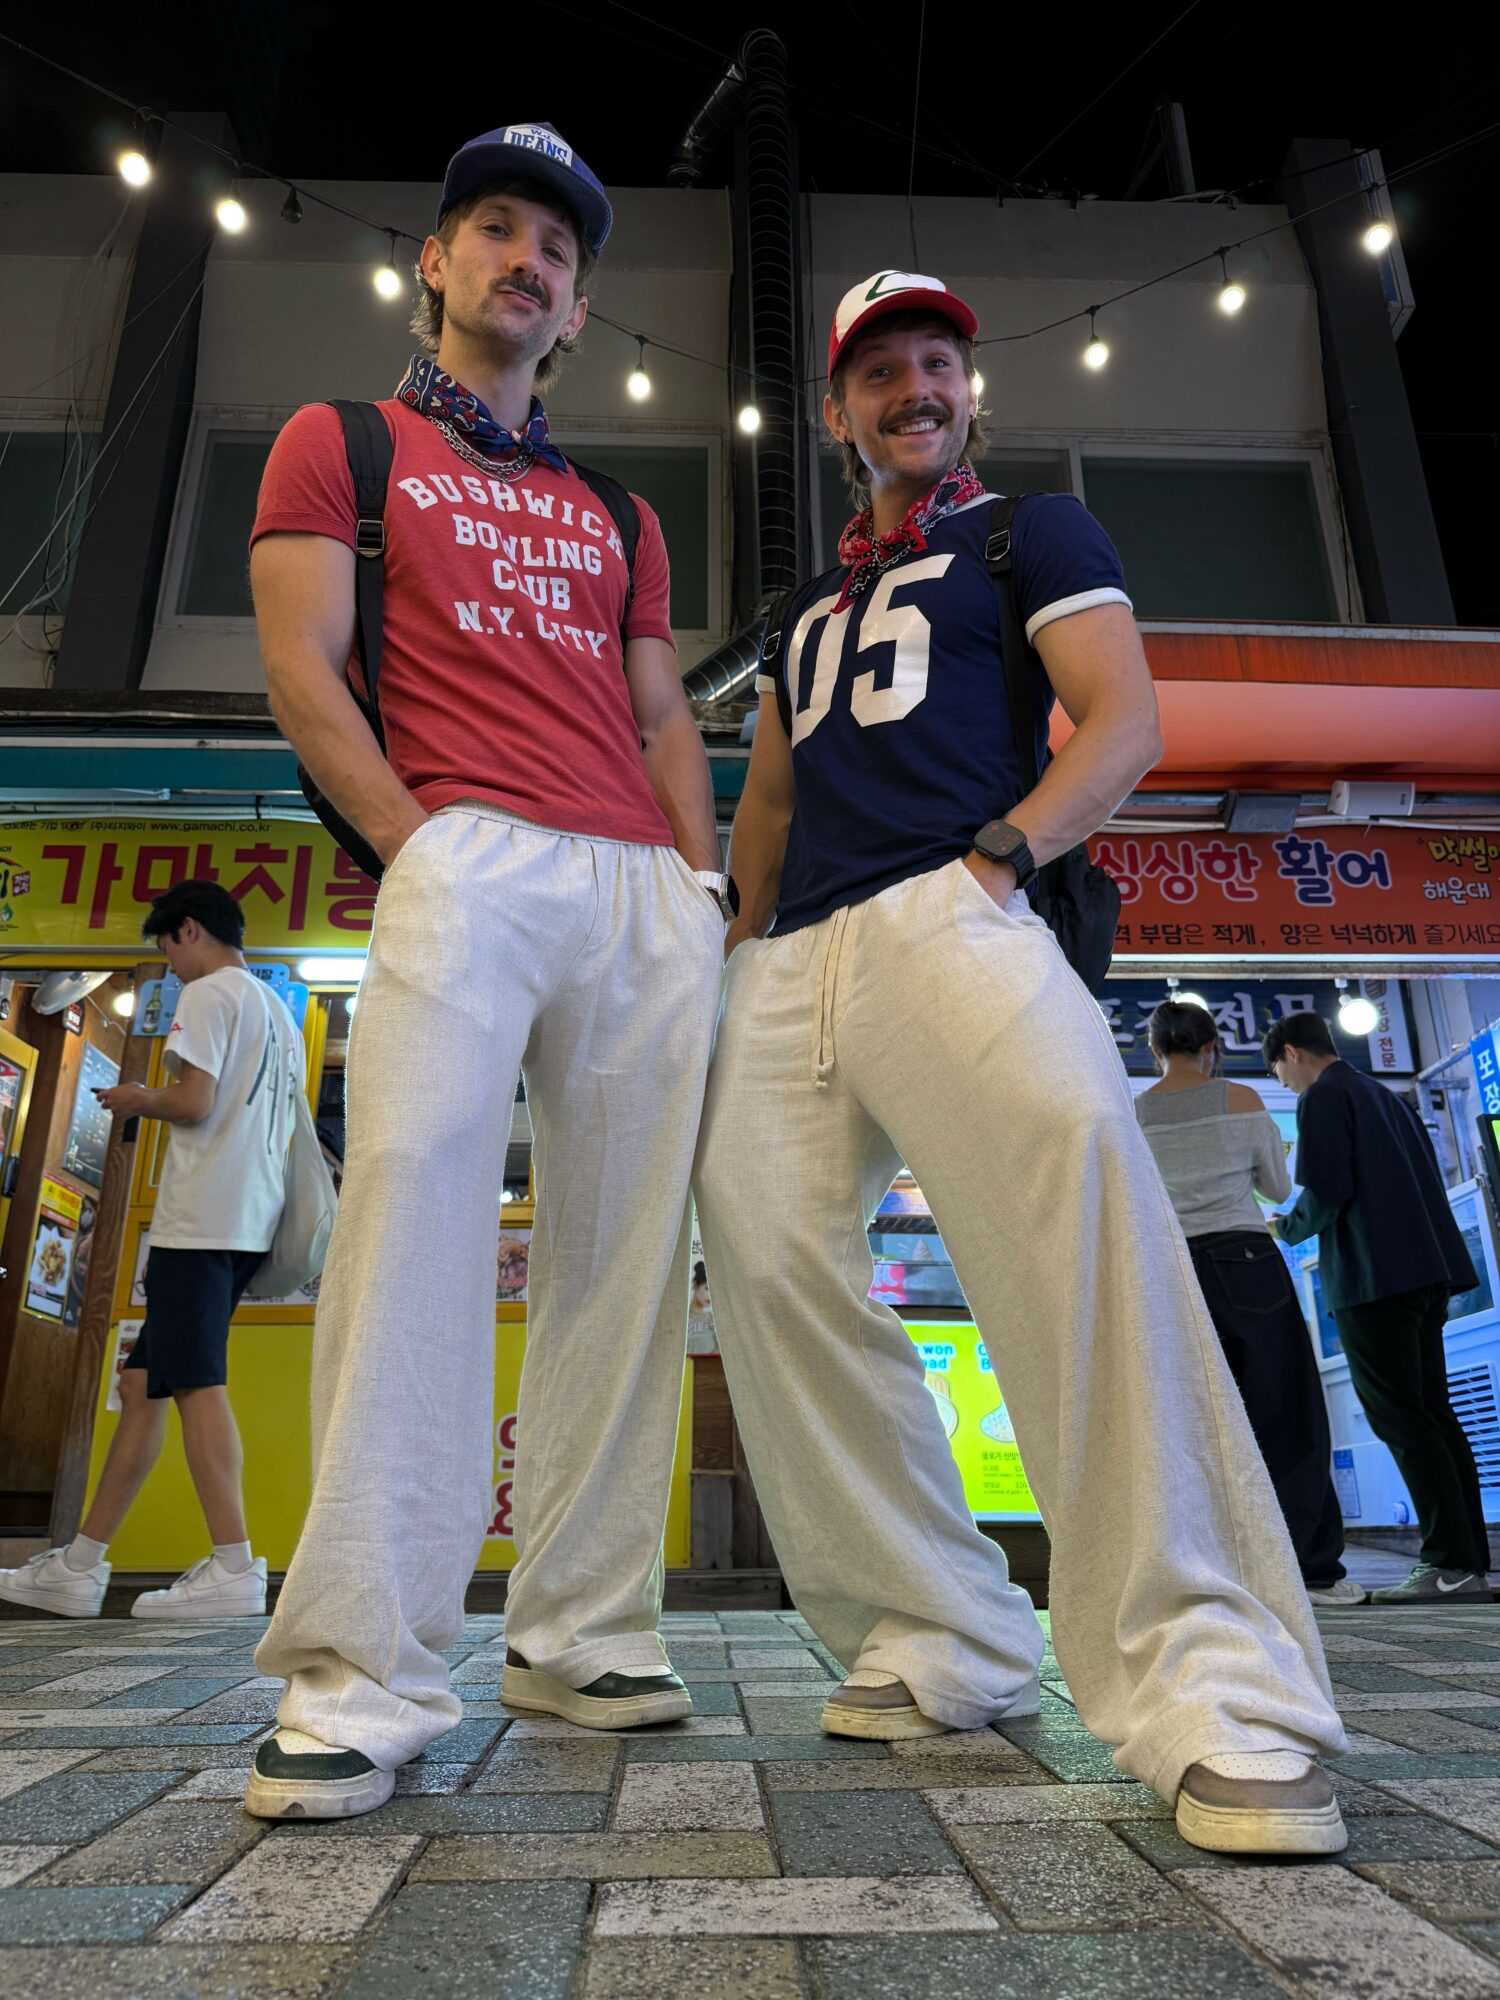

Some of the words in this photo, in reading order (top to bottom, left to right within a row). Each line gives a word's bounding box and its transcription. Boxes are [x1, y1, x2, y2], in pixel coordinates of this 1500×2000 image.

[397, 474, 624, 560] BUSHWICK
[452, 513, 602, 576] BOWLING
[454, 601, 524, 639] N.Y.
[535, 612, 608, 659] CITY
[788, 554, 956, 749] 05
[151, 822, 272, 832] www.gamachi.co.kr
[1095, 840, 1261, 904] 싱싱한
[1272, 833, 1393, 908] 활어
[1421, 876, 1492, 905] 해운대
[1140, 923, 1205, 945] 부담은
[1211, 923, 1266, 947] 적게,
[1279, 923, 1323, 945] 양은
[1329, 923, 1417, 945] 넉넉하게
[1423, 923, 1500, 945] 즐기세요
[923, 1345, 953, 1355] won
